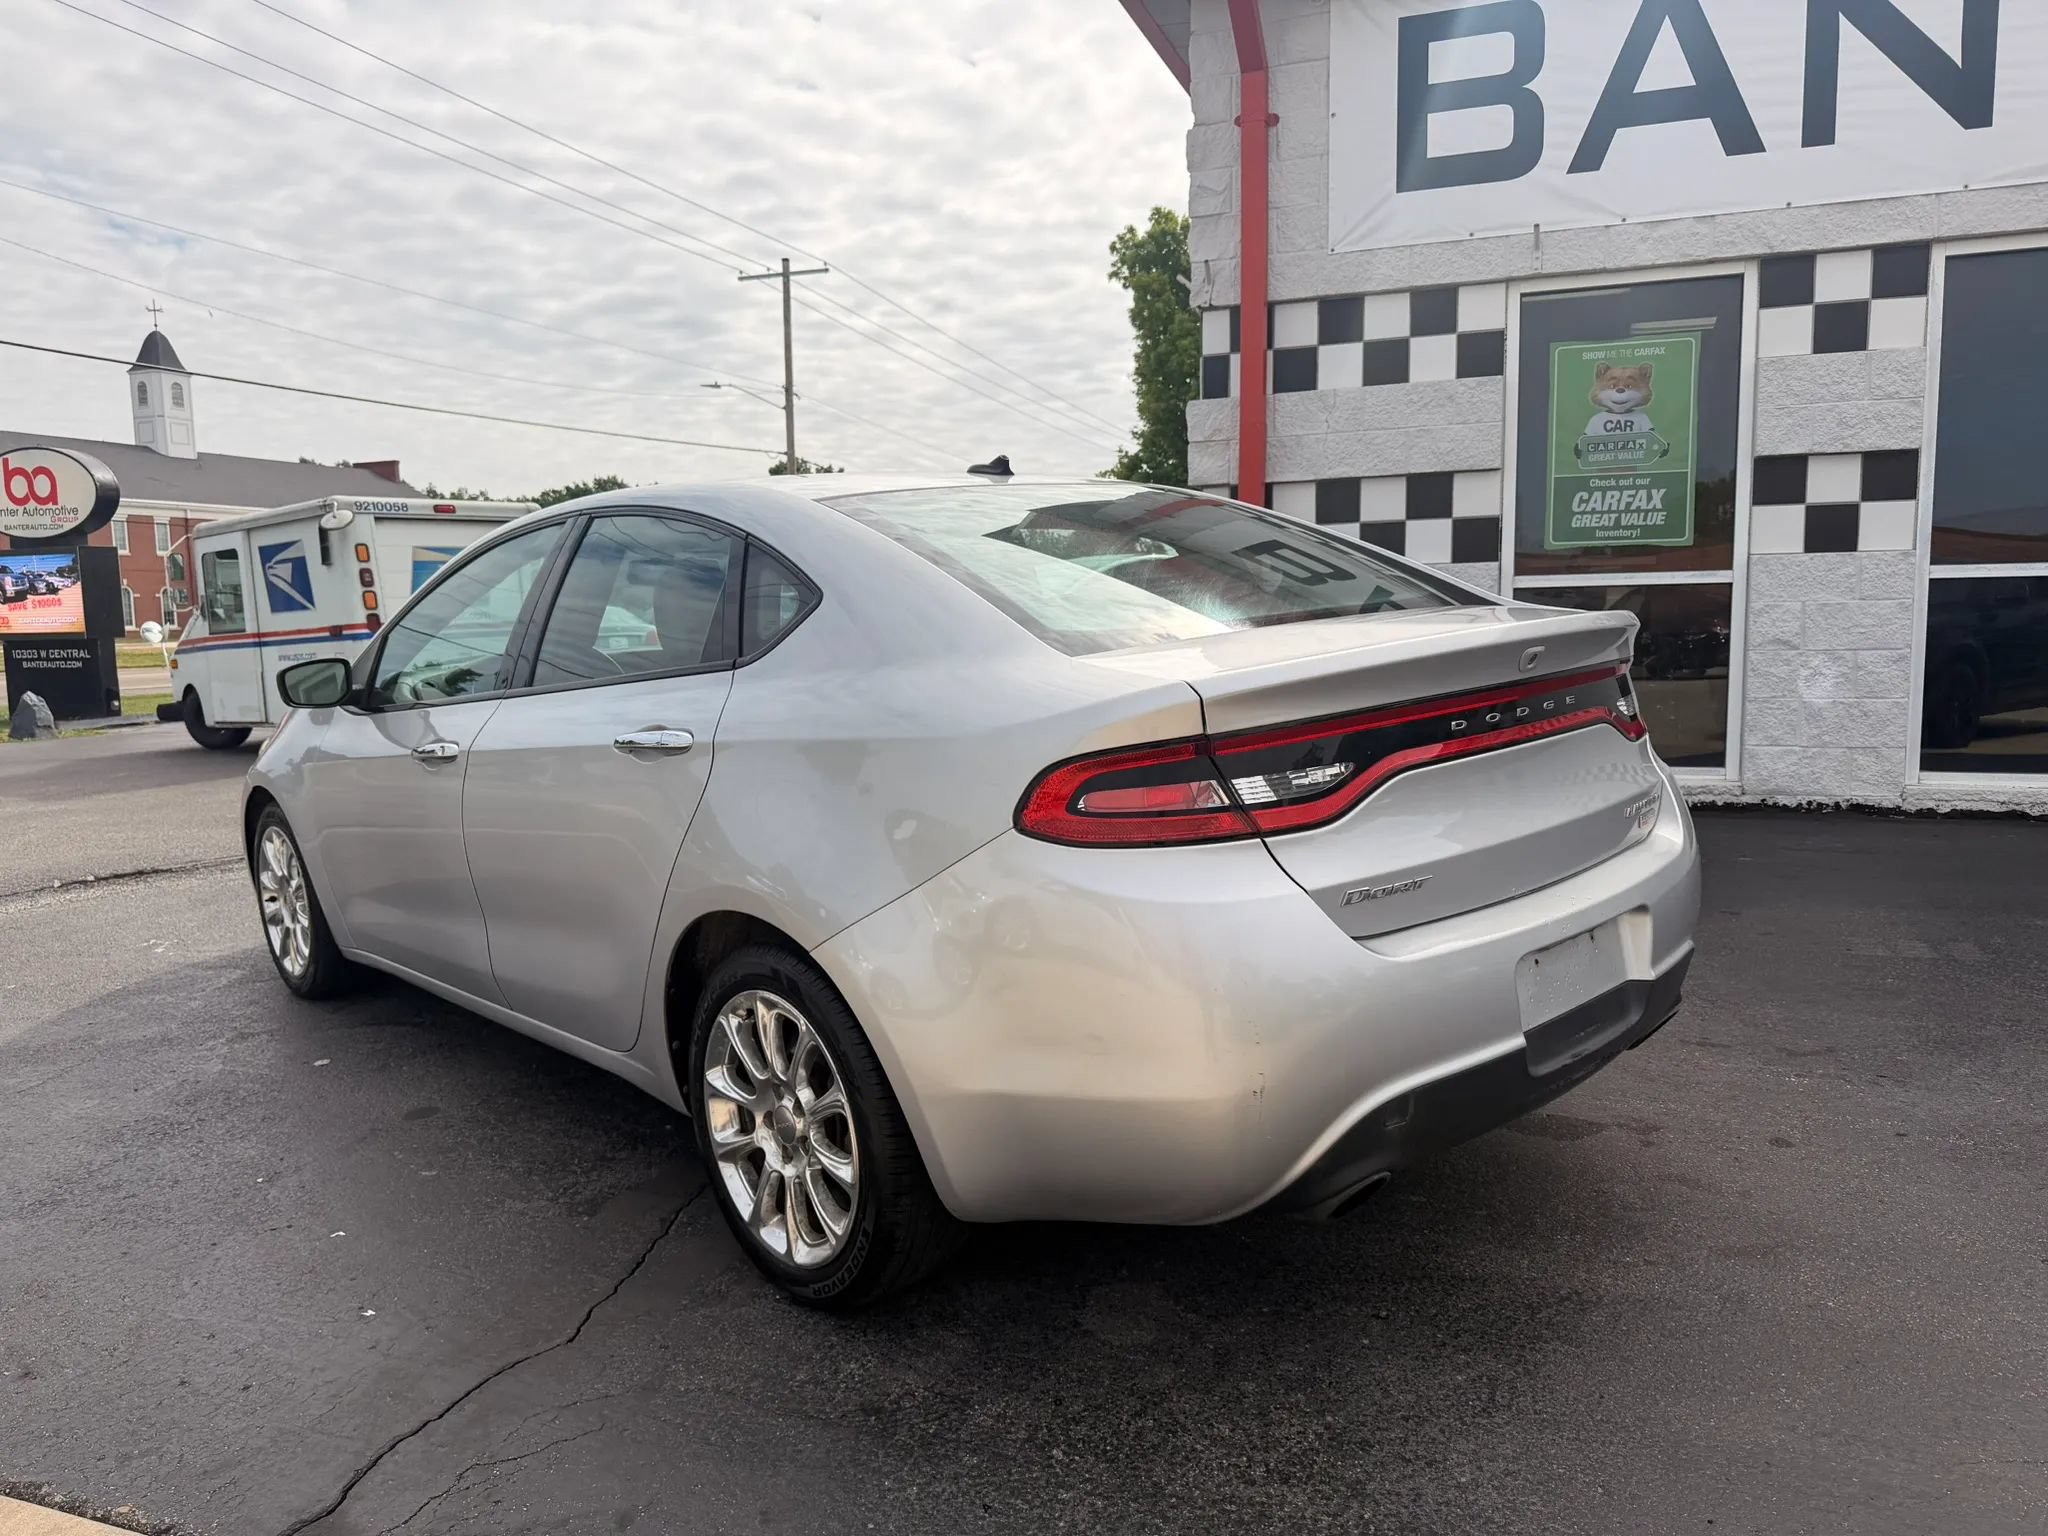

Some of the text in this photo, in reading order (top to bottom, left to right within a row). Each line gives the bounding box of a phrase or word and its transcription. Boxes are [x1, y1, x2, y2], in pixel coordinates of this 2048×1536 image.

[1582, 351, 1606, 360] SHOW
[1634, 347, 1666, 357] CARFAX
[1603, 420, 1635, 432] CAR
[1588, 440, 1646, 452] CARFAX
[1588, 451, 1645, 462] GREAT VALUE
[1590, 477, 1651, 487] Check out our
[1571, 488, 1666, 512] CARFAX
[22, 505, 79, 517] Automotive
[354, 501, 409, 512] 9210058
[1571, 511, 1667, 528] GREAT VALUE
[1595, 528, 1640, 538] Inventory!
[7, 602, 28, 612] SAVE
[12, 649, 92, 659] 10303 W CENTRAL
[1451, 695, 1576, 731] DODGE
